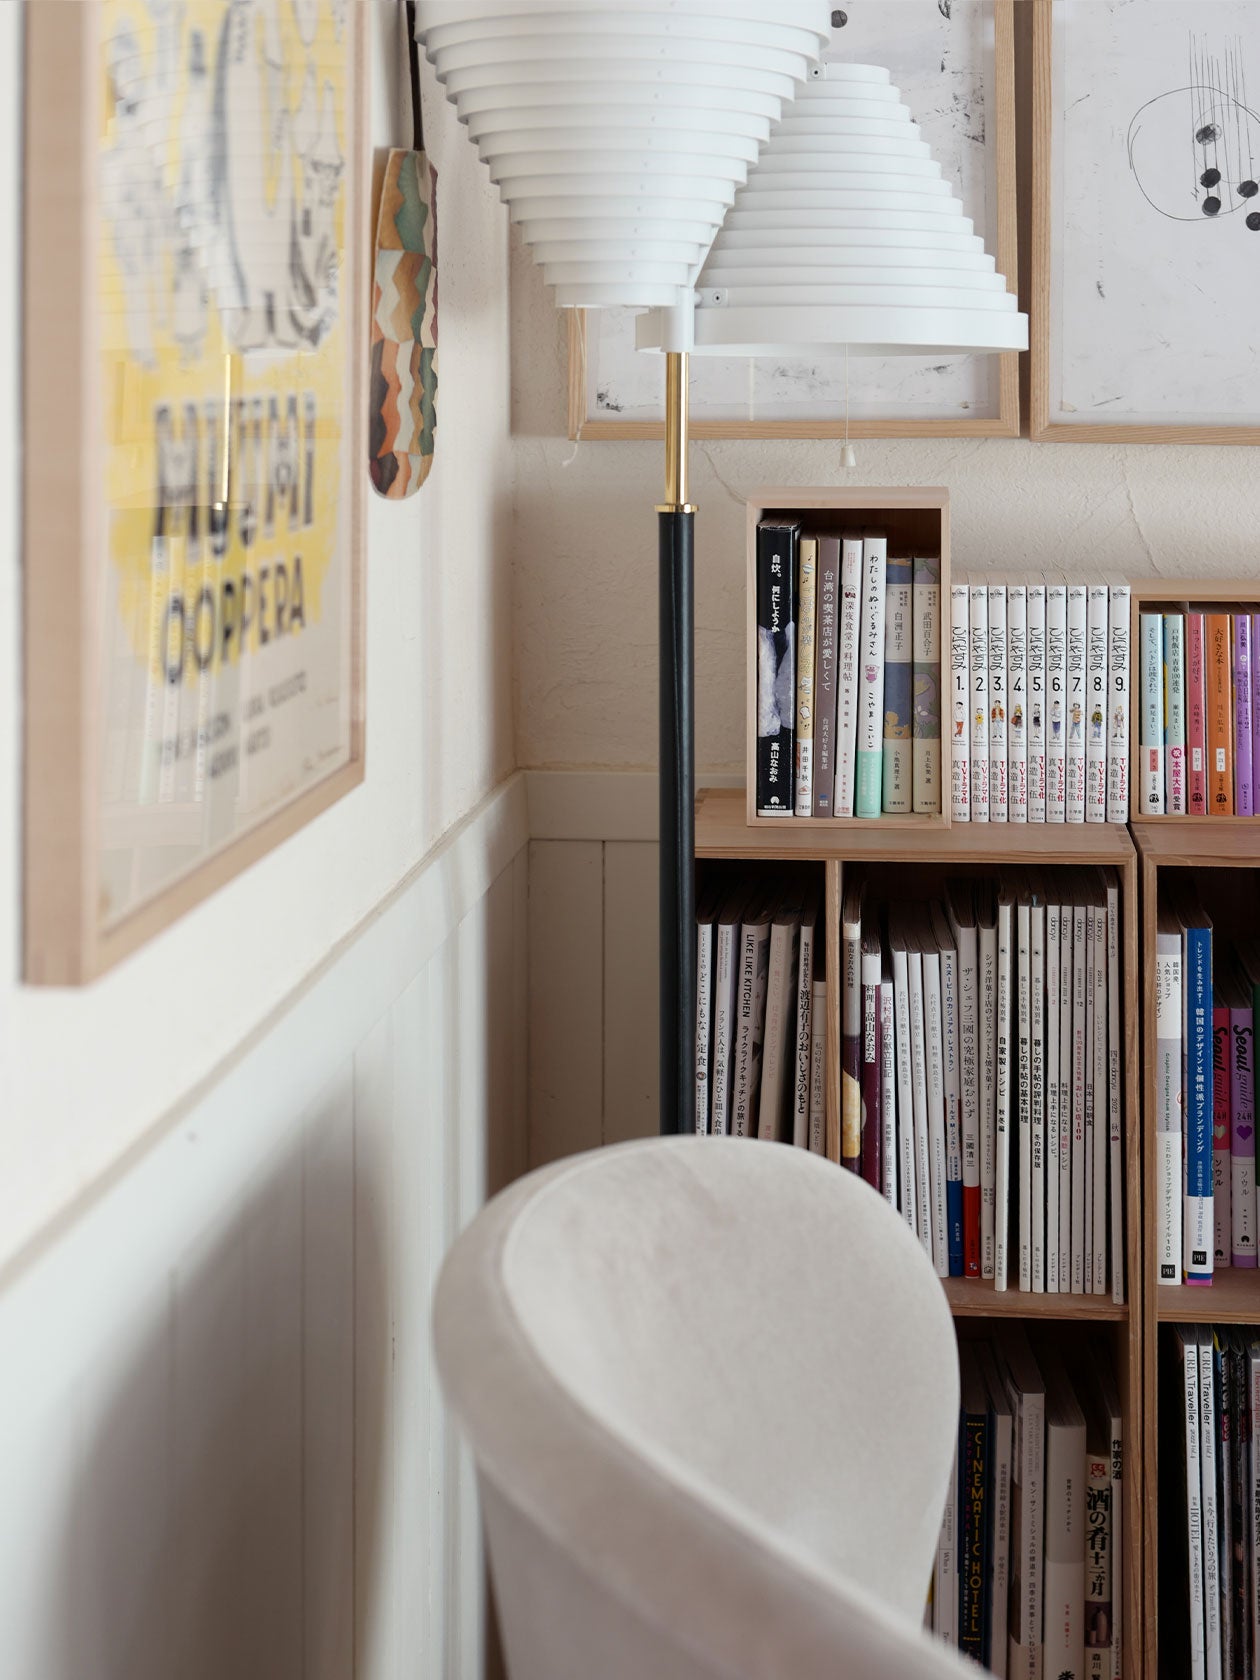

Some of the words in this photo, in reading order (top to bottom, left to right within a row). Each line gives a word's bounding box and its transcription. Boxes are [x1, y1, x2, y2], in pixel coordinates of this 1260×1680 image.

[771, 585, 781, 633] 何にしようか
[868, 555, 879, 656] わたしのぬいぐるみさん
[821, 570, 834, 691] 台湾の喫茶店が愛しくて
[842, 601, 855, 682] 深夜食堂の料理帖
[894, 612, 903, 651] 白洲正子
[923, 612, 932, 656] 武田百合子
[1214, 627, 1224, 665] 大好きな本
[1192, 629, 1200, 683] コットンが好き
[956, 675, 965, 691] 1.
[975, 676, 986, 691] 2.
[993, 676, 1004, 691] 3.
[1013, 676, 1024, 691] 4.
[1032, 676, 1043, 691] 5.
[1052, 676, 1063, 691] 6.
[1072, 677, 1082, 692] 7.
[1093, 676, 1104, 691] 8.
[1115, 676, 1126, 691] 9.
[768, 742, 780, 783] 高山なおみ
[801, 746, 809, 782] 井田千秋
[952, 760, 960, 804] 真造圭伍
[991, 760, 999, 804] 真造圭伍
[1010, 761, 1019, 804] 真造圭伍
[1029, 755, 1037, 799] 真造圭伍
[1048, 757, 1056, 802] 真造圭伍
[1068, 757, 1076, 801] 真造圭伍
[1089, 760, 1097, 805] 真造圭伍
[1110, 756, 1118, 801] 真造圭伍
[1172, 760, 1181, 811] 本屋大賞受賞
[746, 934, 755, 954] LIKE
[1049, 916, 1058, 941] dancyu
[1062, 916, 1070, 941] dancyu
[1075, 918, 1085, 943] dancyu
[1096, 918, 1105, 943] dancyu
[744, 956, 754, 976] LIKE
[742, 977, 753, 1018] KITCHEN
[946, 963, 954, 1072] スヌーピーのカジュアル・レストラン
[797, 990, 810, 1114] 渡辺有子のおいしさのもと
[883, 996, 893, 1078] 沢村貞子の献立日記
[1233, 1024, 1253, 1072] Seoul
[737, 1025, 749, 1136] ライクライクキッチンの旅する
[814, 1041, 822, 1106] 私の好きな料理の本
[998, 1036, 1007, 1097] 自家製レシピ
[1020, 1037, 1029, 1124] 暮しの手帖の基本料理
[1033, 1039, 1042, 1126] 暮しの手帖の評判料理
[1195, 1008, 1205, 1153] 韓国のデザインと個性派ブランディング
[1237, 1112, 1252, 1120] 24H
[1215, 1159, 1223, 1186] ソウル
[1241, 1170, 1250, 1196] ソウル
[1186, 1350, 1196, 1380] CREA
[1202, 1350, 1211, 1380] CREA
[1187, 1380, 1198, 1426] Traveller
[1203, 1380, 1212, 1426] Traveller
[971, 1432, 984, 1556] CINEMATIC
[970, 1561, 982, 1632] HOTEL
